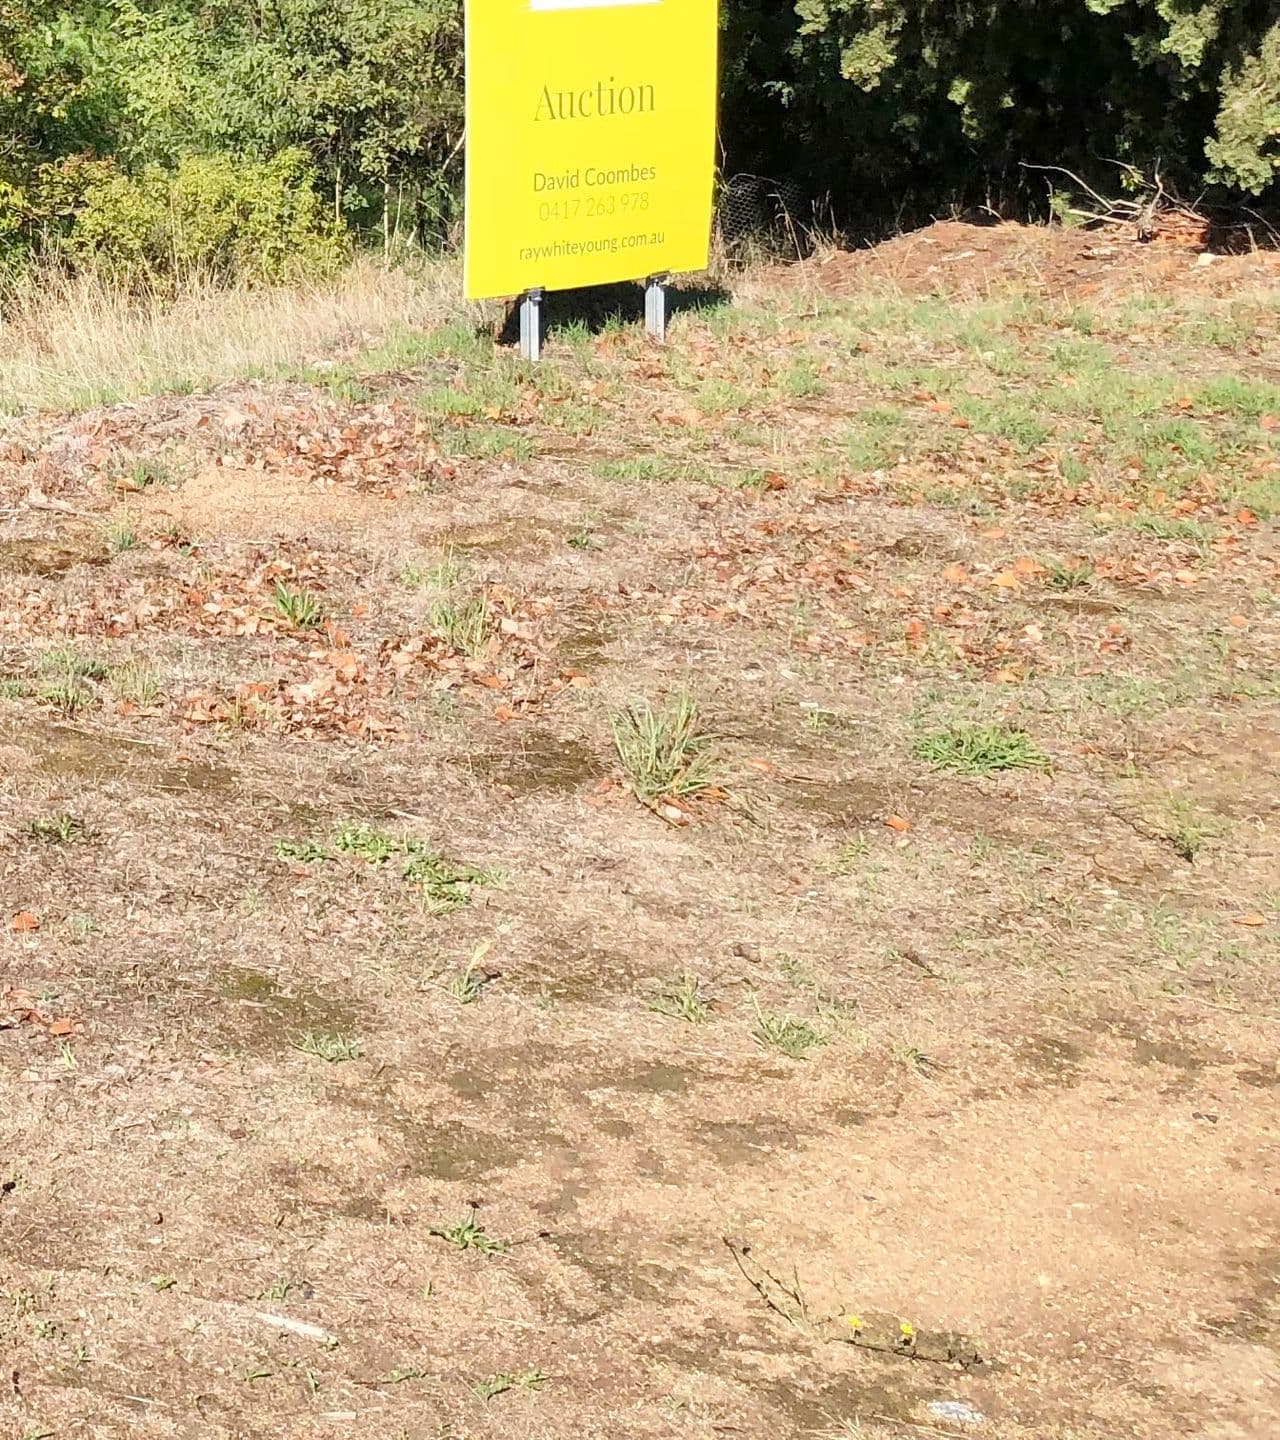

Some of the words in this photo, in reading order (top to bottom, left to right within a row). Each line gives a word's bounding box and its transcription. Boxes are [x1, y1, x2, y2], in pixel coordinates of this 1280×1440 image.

[533, 76, 656, 122] Auction
[533, 169, 580, 193] David
[584, 163, 656, 187] Coombes
[538, 199, 581, 222] 0417
[586, 195, 616, 217] 263
[620, 191, 650, 212] 978
[519, 231, 665, 263] raywhiteyoung.com.au
